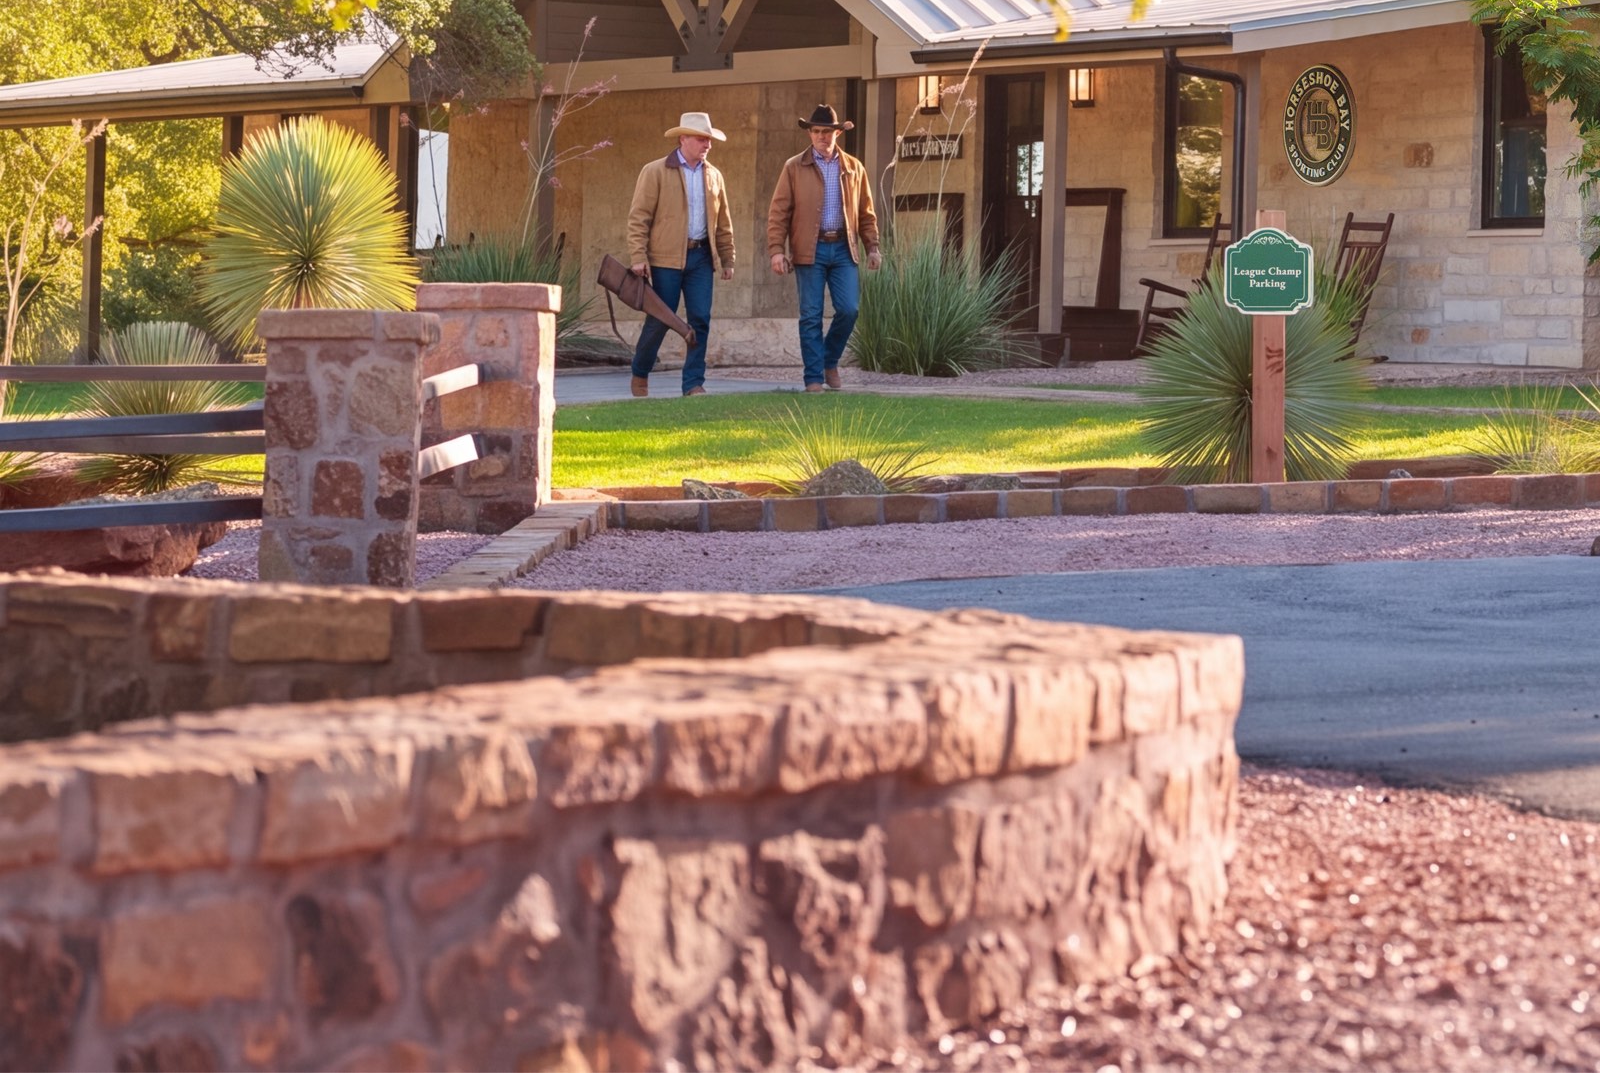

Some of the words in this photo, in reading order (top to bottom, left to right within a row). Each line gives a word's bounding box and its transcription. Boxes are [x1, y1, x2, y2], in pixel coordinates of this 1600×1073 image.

[1285, 71, 1339, 131] HORSESHOE
[1336, 94, 1350, 131] BAY
[1289, 144, 1325, 178] SPORTING
[1326, 144, 1346, 171] CLUB
[1234, 267, 1266, 278] League
[1268, 267, 1301, 278] Champ
[1249, 279, 1286, 290] Parking
